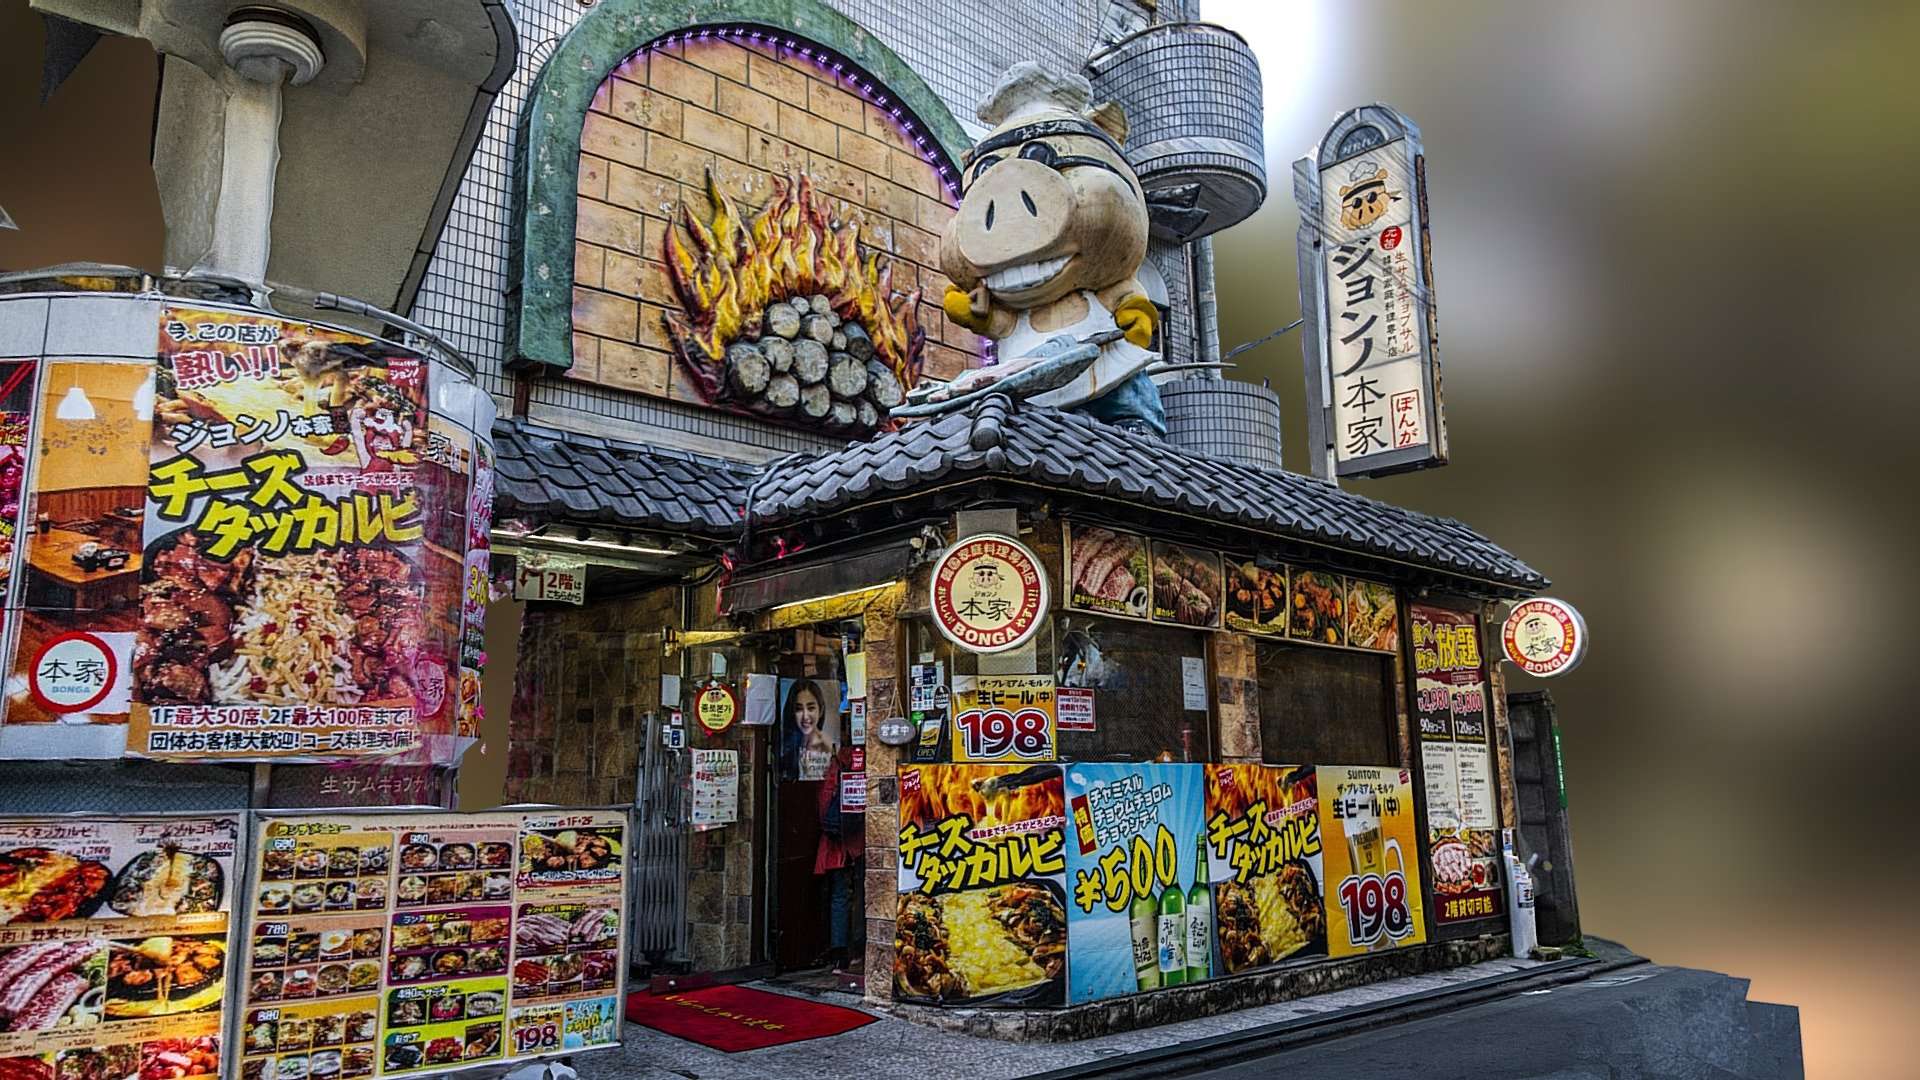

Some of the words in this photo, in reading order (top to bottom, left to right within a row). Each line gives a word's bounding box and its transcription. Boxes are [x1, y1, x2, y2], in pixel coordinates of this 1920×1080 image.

[168, 322, 278, 343] 今、この店が
[149, 453, 307, 521] チーズ
[199, 488, 426, 560] タッカルビ
[546, 571, 582, 591] 2階は
[957, 598, 1015, 622] 本家
[952, 621, 1020, 646] BONGA
[38, 658, 105, 683] 本家
[1525, 653, 1570, 673] BONGA
[977, 690, 1054, 706] 生ビール(中)
[979, 678, 1052, 689] ザ・プレミアム・モルツ
[957, 708, 1049, 758] 198
[1347, 769, 1381, 780] SUNTORY
[1090, 774, 1143, 807] チャミスル
[1093, 783, 1173, 827] チョウムチョロム
[1332, 797, 1401, 819] 生ビール(中)
[899, 815, 973, 866] チーズ
[1208, 801, 1270, 857] チーズ
[917, 830, 1065, 895] タッカルビ
[1231, 815, 1321, 884] タッカルビ
[1074, 825, 1177, 913] ¥500
[1340, 873, 1409, 943] 198
[514, 1023, 557, 1050] 198
